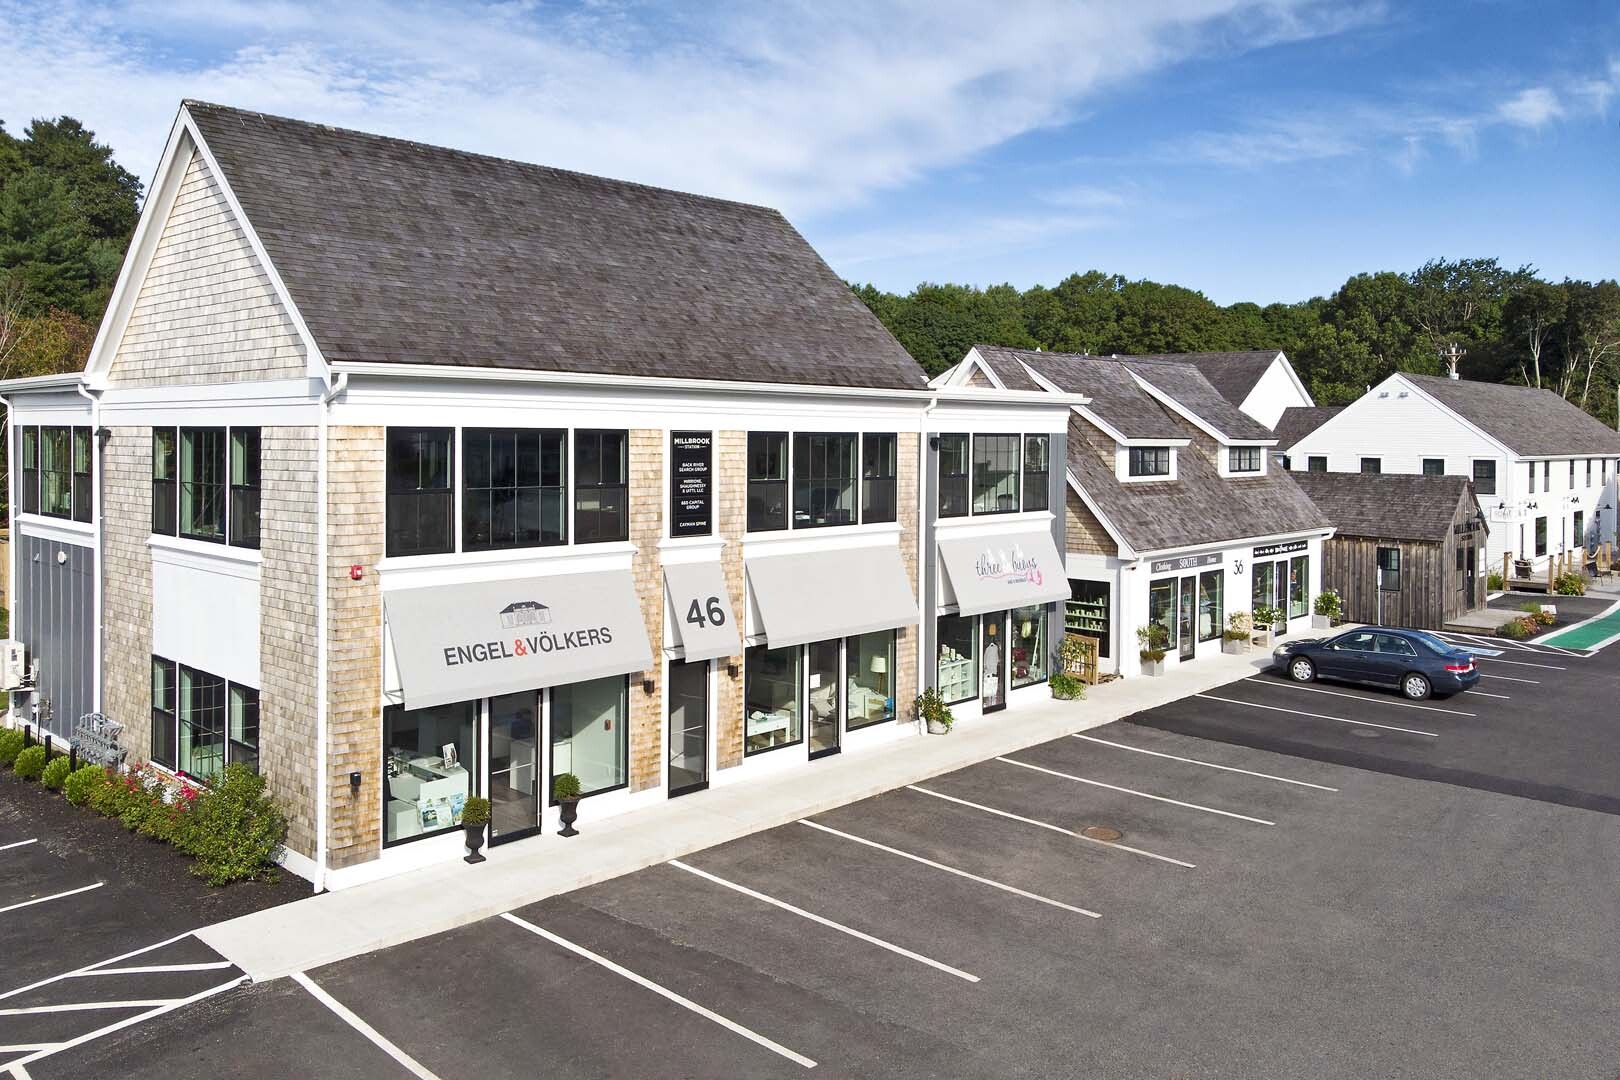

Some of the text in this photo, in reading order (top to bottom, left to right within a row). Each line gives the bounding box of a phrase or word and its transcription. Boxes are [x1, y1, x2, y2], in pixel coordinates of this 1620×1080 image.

[976, 553, 1001, 576] three
[1179, 557, 1197, 568] SOUTH
[1233, 559, 1243, 575] 36
[686, 596, 725, 628] 46
